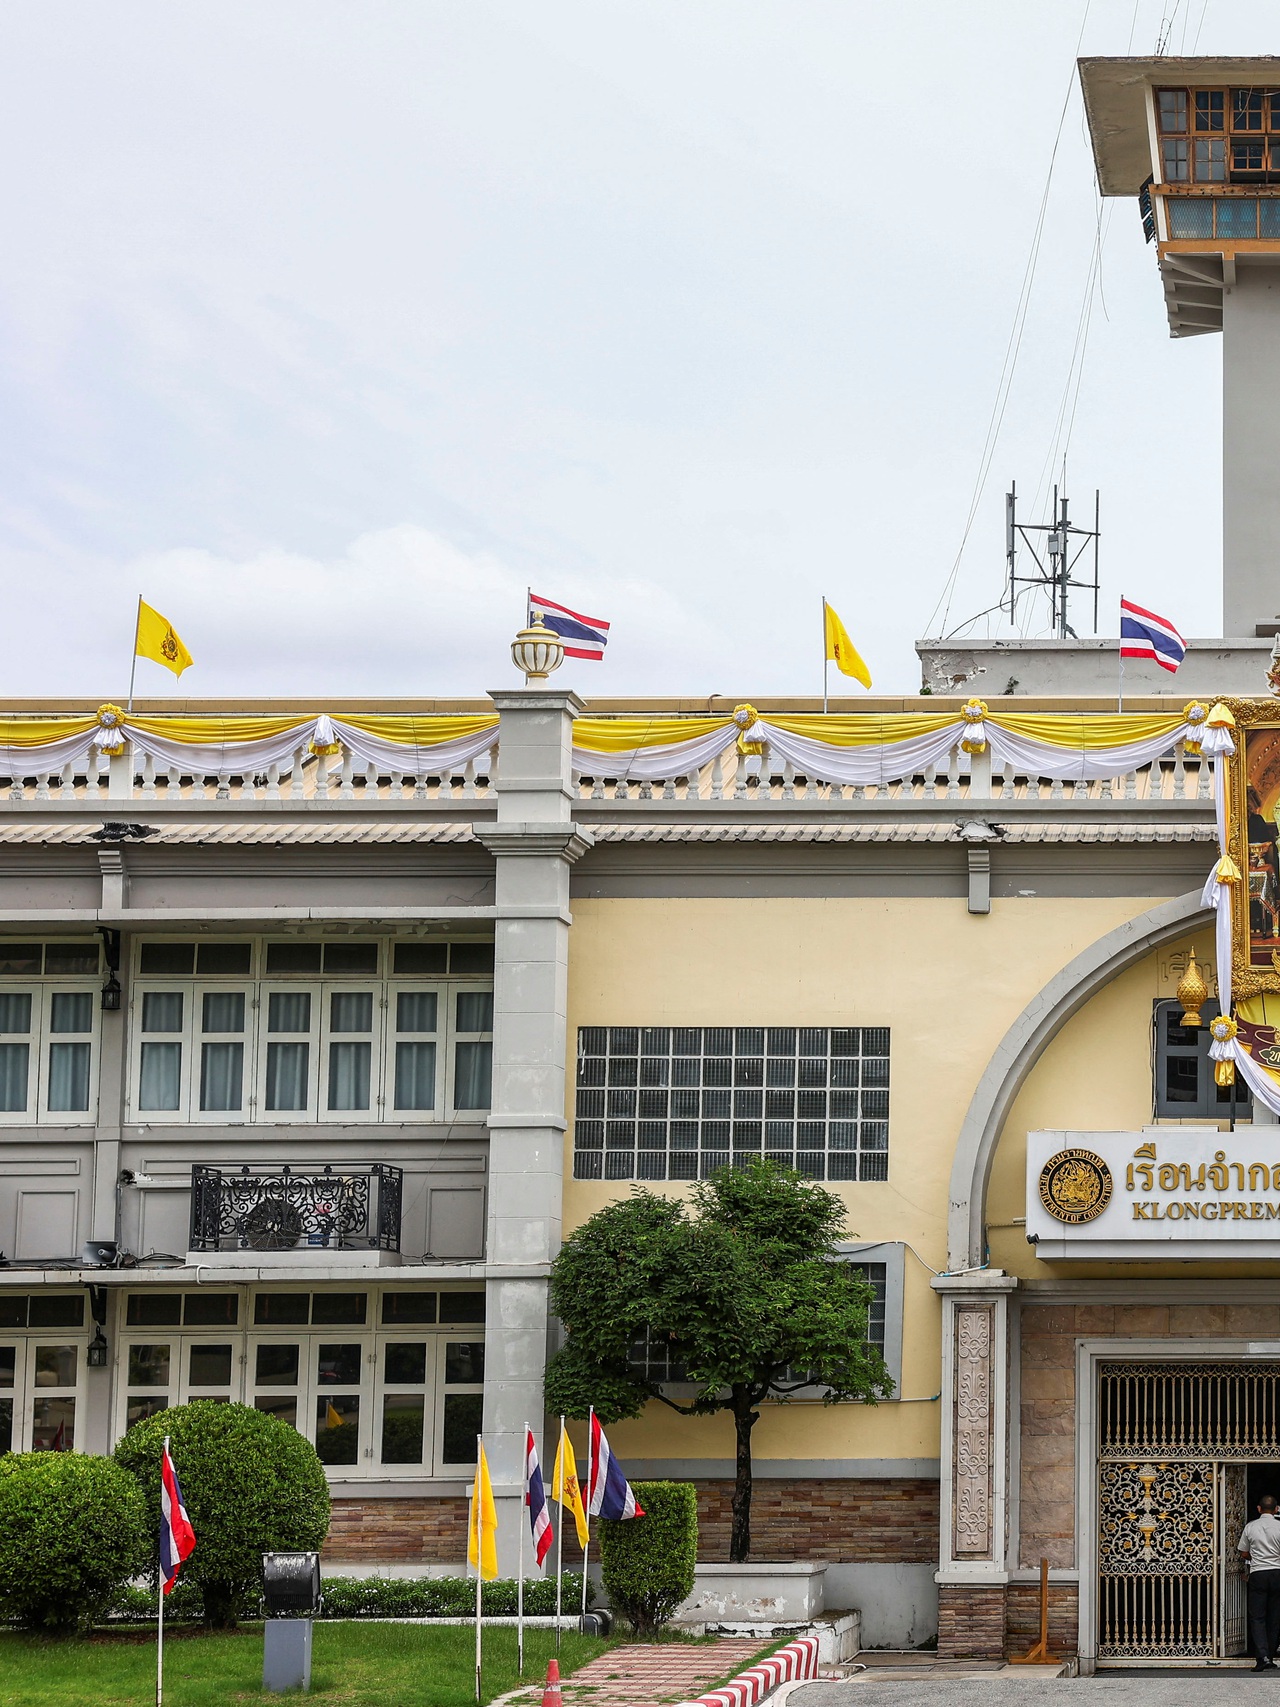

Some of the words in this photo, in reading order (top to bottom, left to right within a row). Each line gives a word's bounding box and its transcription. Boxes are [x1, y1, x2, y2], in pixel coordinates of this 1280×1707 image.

[1039, 1173, 1071, 1221] DEPARTMENT
[1070, 1213, 1081, 1222] OF
[1083, 1173, 1112, 1219] CORRECTIONS
